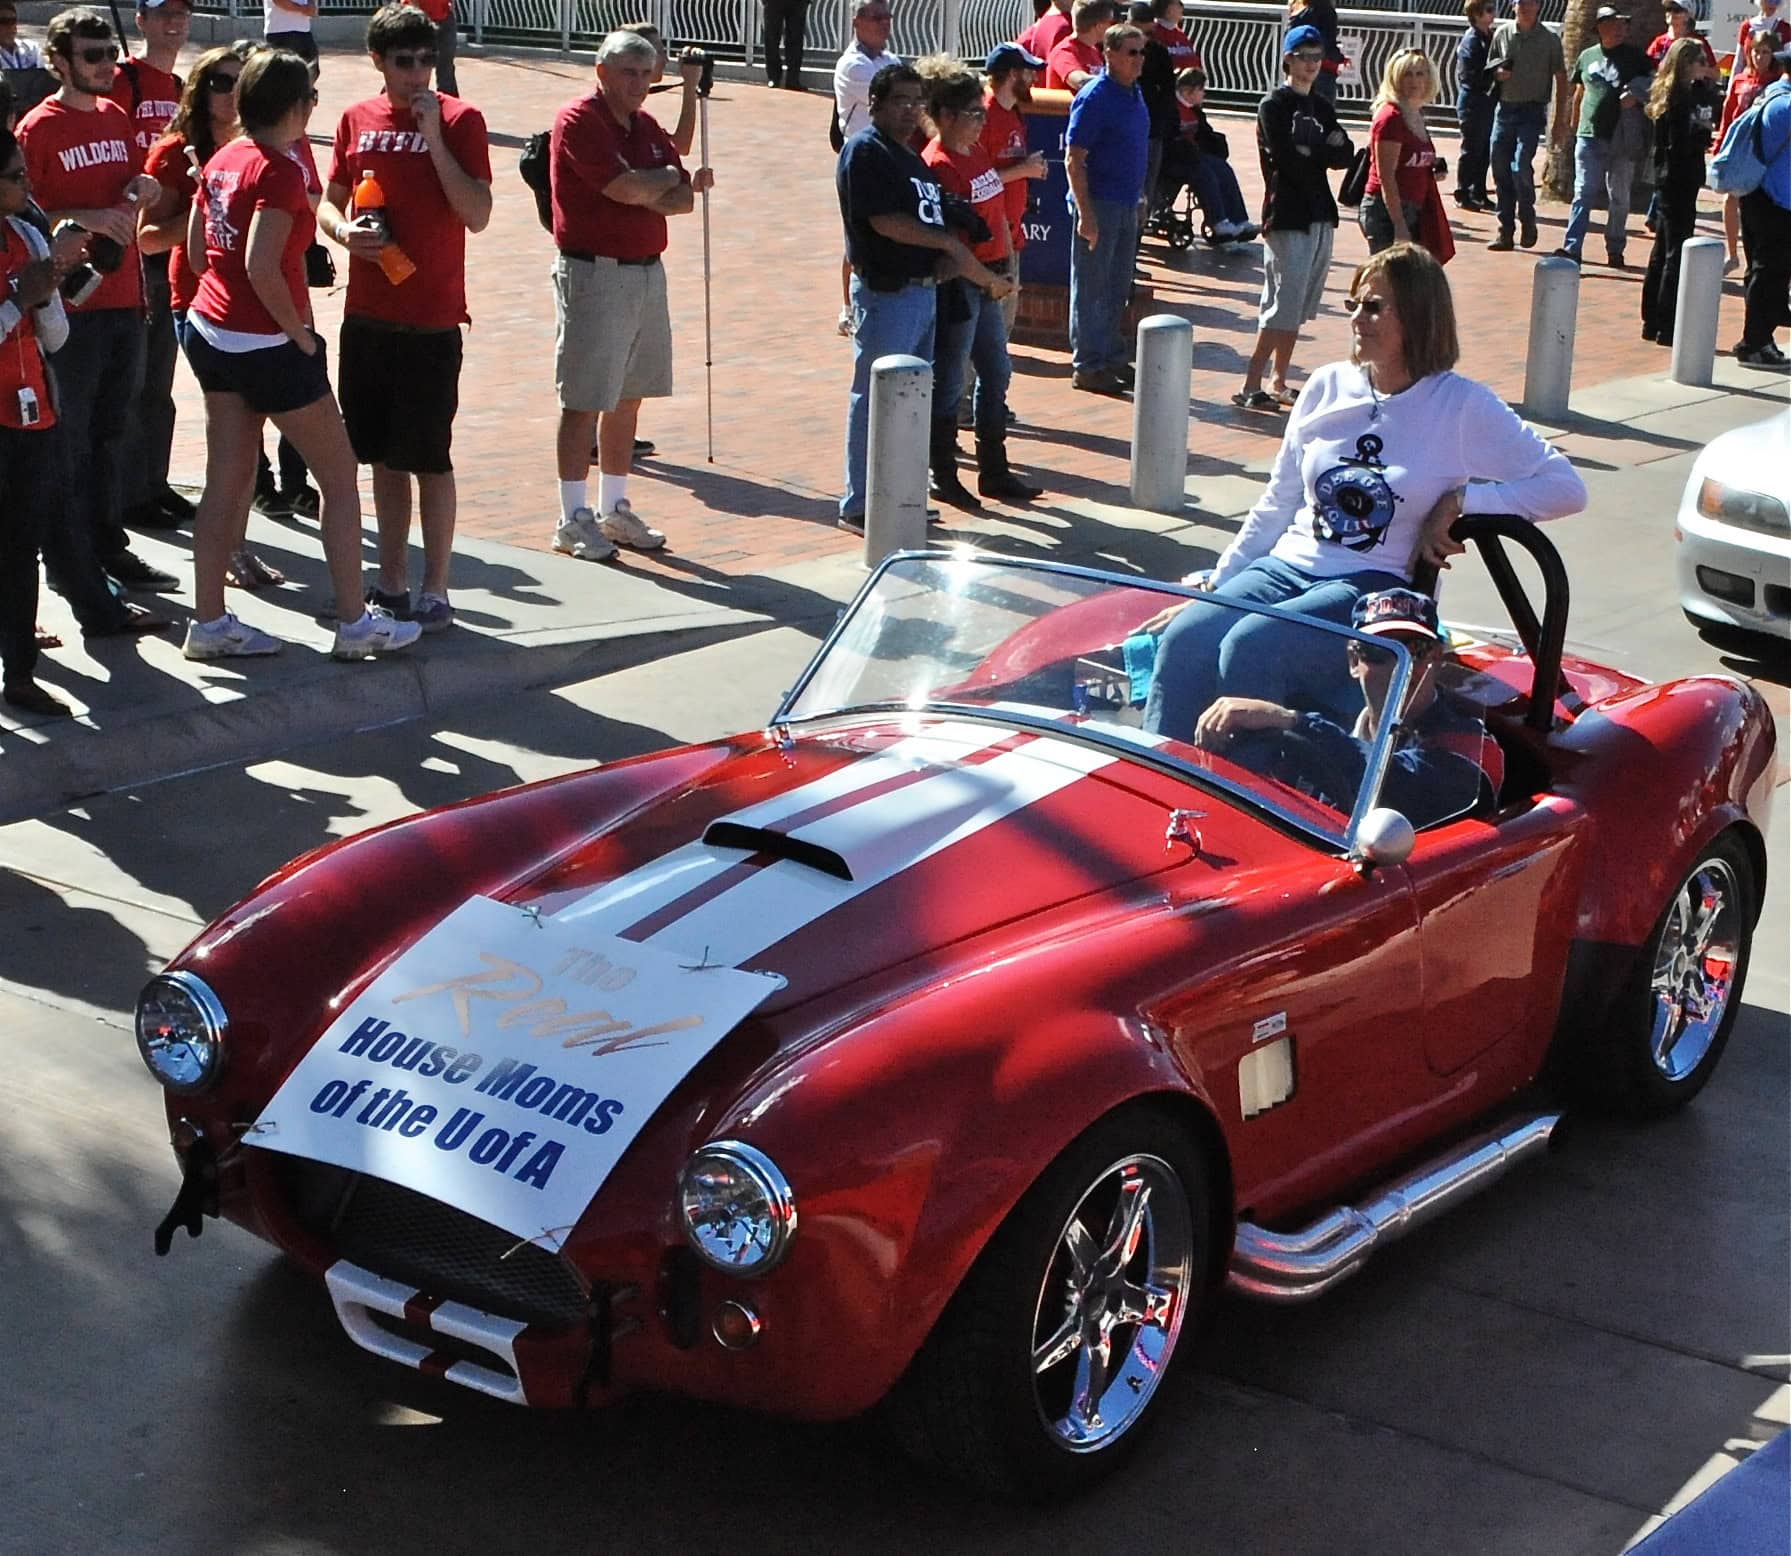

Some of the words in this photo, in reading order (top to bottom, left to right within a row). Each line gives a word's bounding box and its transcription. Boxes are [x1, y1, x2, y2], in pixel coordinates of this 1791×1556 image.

[391, 951, 705, 1057] Real
[338, 1016, 484, 1085] House
[474, 1056, 625, 1135] Moms
[309, 1079, 374, 1119] of
[355, 1087, 438, 1138] the
[433, 1107, 486, 1152] U
[468, 1127, 537, 1174] of
[513, 1140, 566, 1191] A
